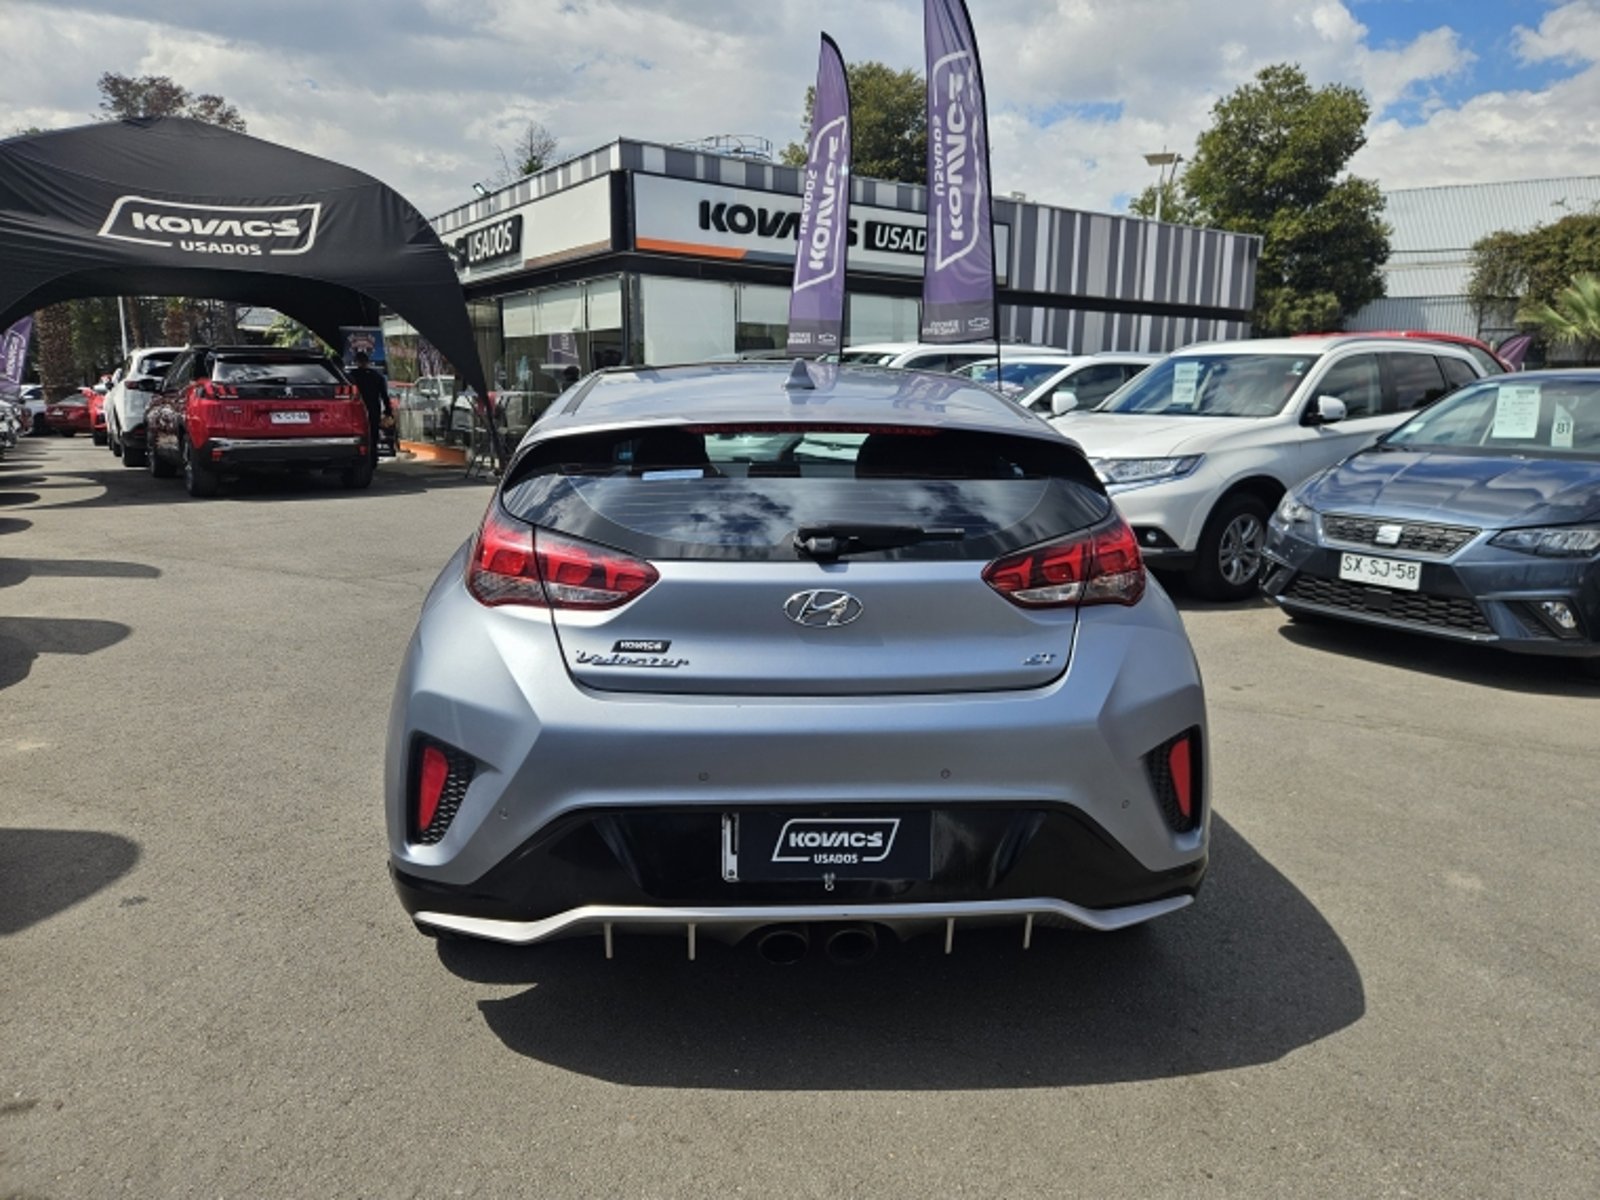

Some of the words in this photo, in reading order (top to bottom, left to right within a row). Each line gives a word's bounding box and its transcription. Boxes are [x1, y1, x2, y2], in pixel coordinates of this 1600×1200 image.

[131, 212, 300, 238] KOVACS
[180, 240, 262, 256] USADOS
[468, 221, 512, 262] USADOS
[789, 832, 883, 847] KOVACS
[814, 854, 859, 865] USADOS
